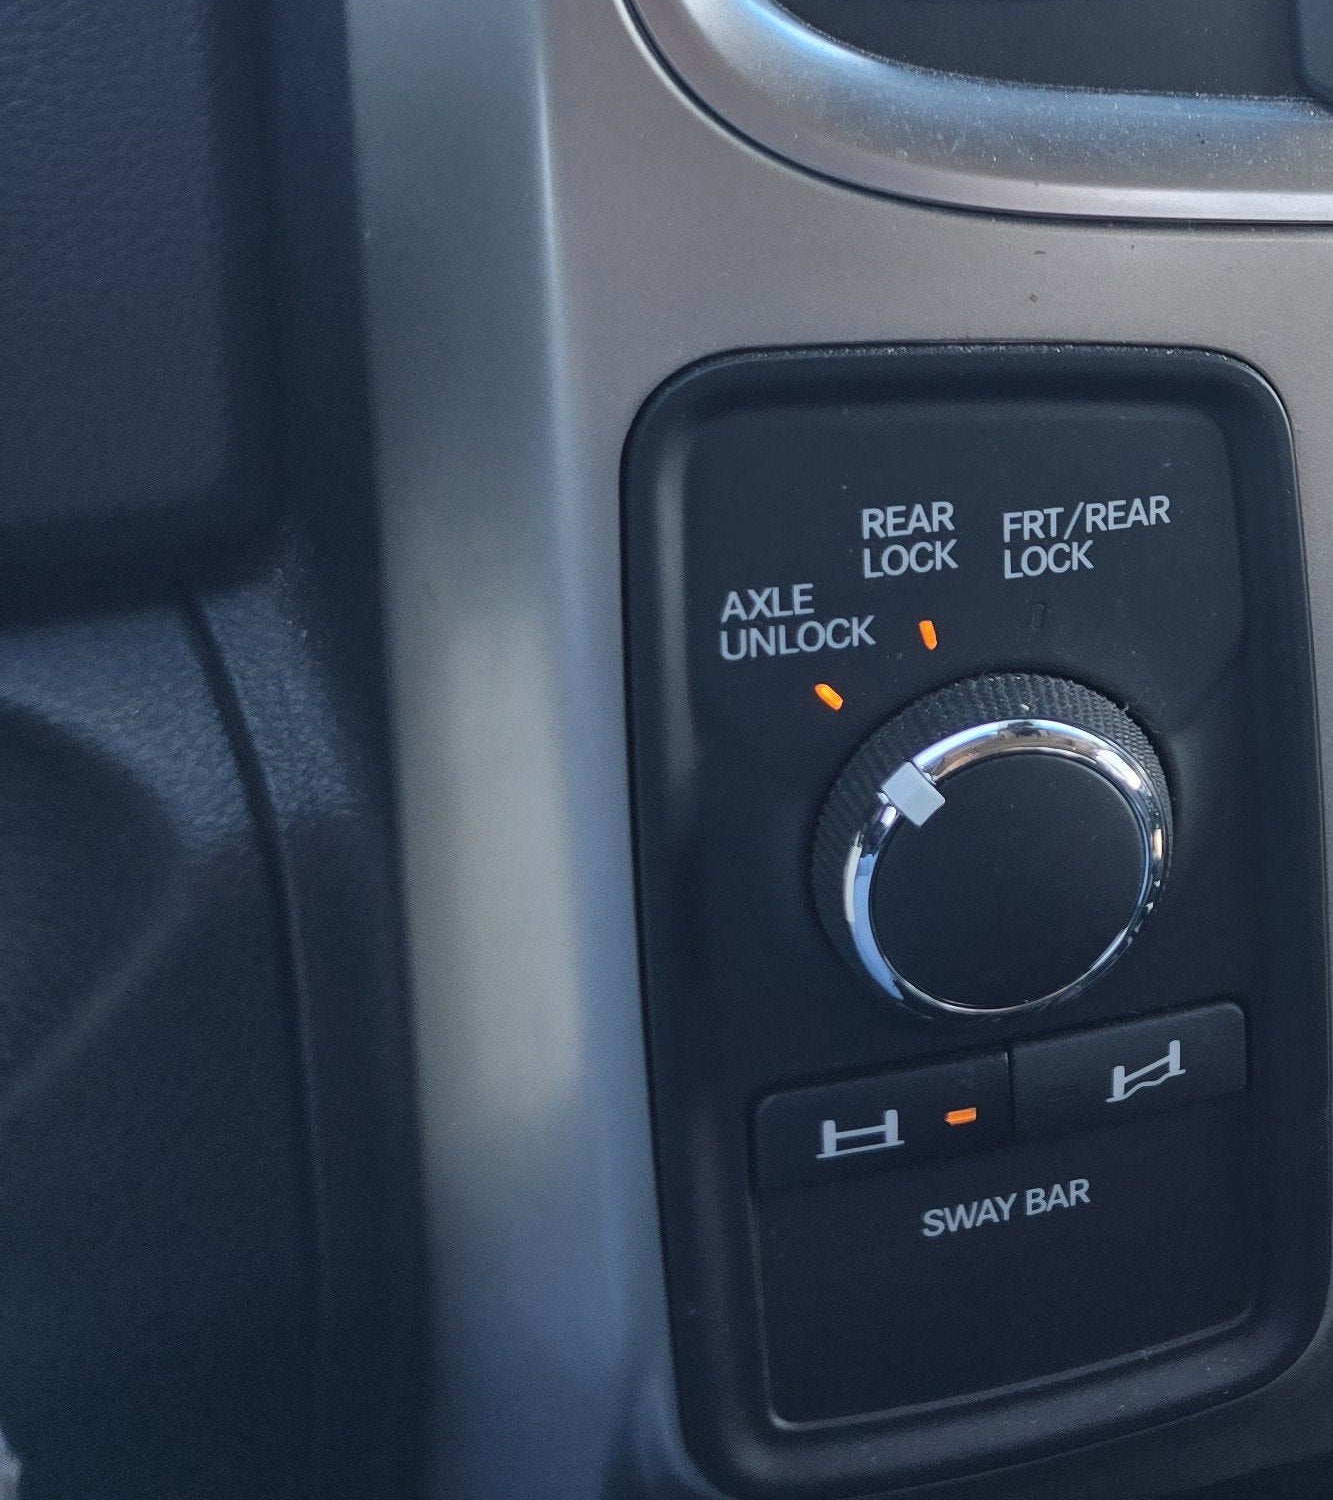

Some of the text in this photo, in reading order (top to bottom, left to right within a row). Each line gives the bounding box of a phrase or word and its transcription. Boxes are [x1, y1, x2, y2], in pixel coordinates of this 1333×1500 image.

[861, 501, 956, 540] REAR
[1001, 494, 1172, 543] FRT/REAR
[862, 538, 959, 579] LOCK
[1003, 540, 1095, 580] LOCK
[719, 583, 815, 624] AXLE
[719, 615, 877, 661] UNLOCK
[920, 1177, 1092, 1238] SWAY BAR
